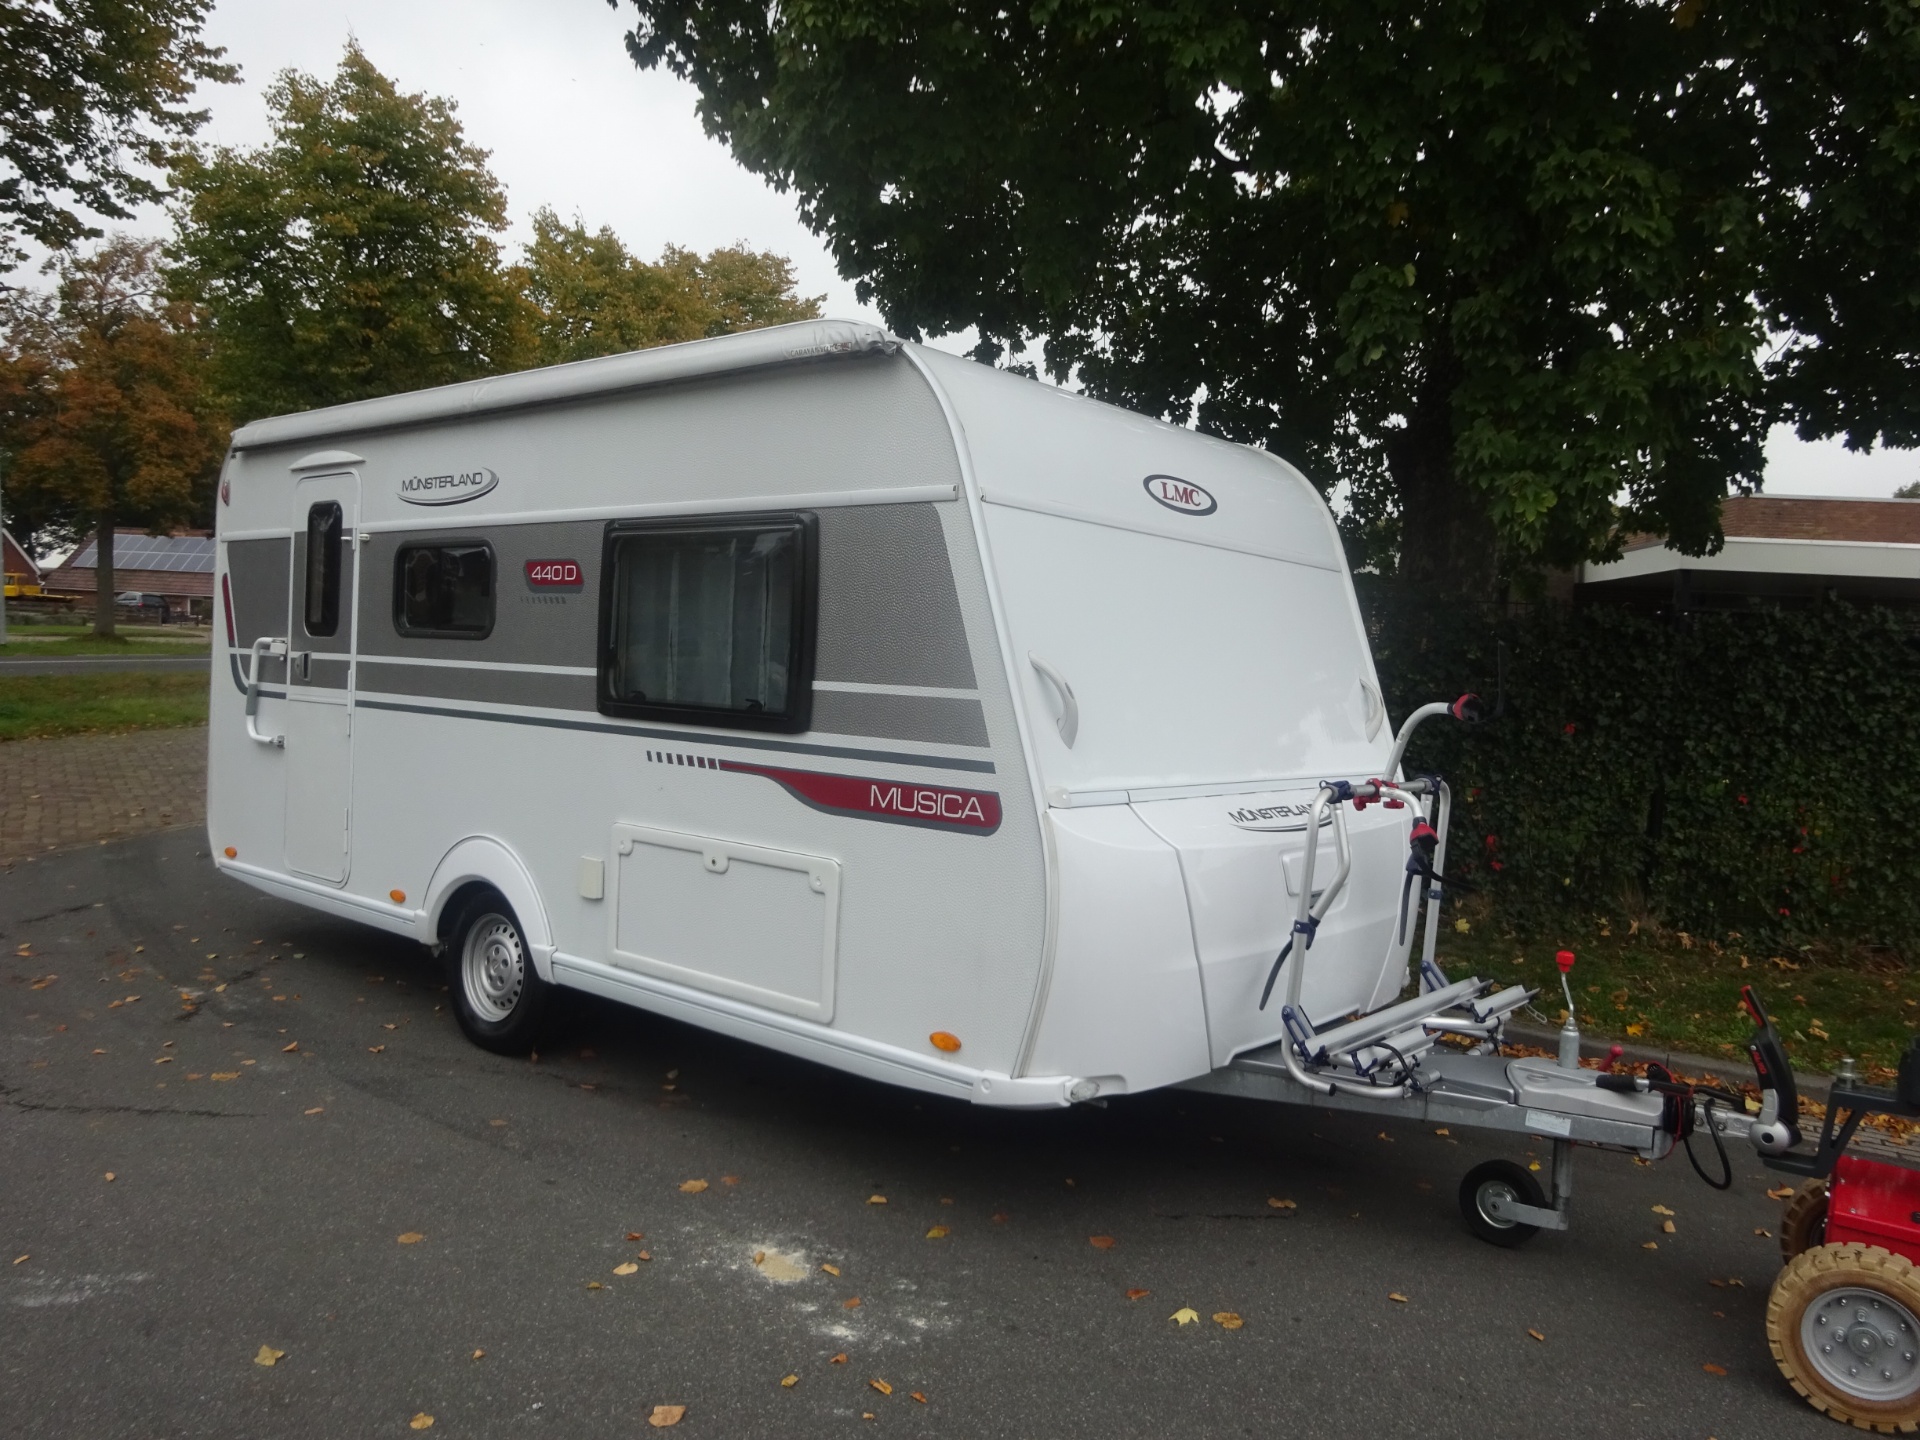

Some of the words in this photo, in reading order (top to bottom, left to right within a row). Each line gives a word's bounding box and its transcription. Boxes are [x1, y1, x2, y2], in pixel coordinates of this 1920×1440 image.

[402, 471, 483, 492] MÜNSTERLAND
[1160, 481, 1201, 507] LMC
[870, 784, 985, 821] MUSICA
[1227, 803, 1323, 823] MÜNSTERLAN
